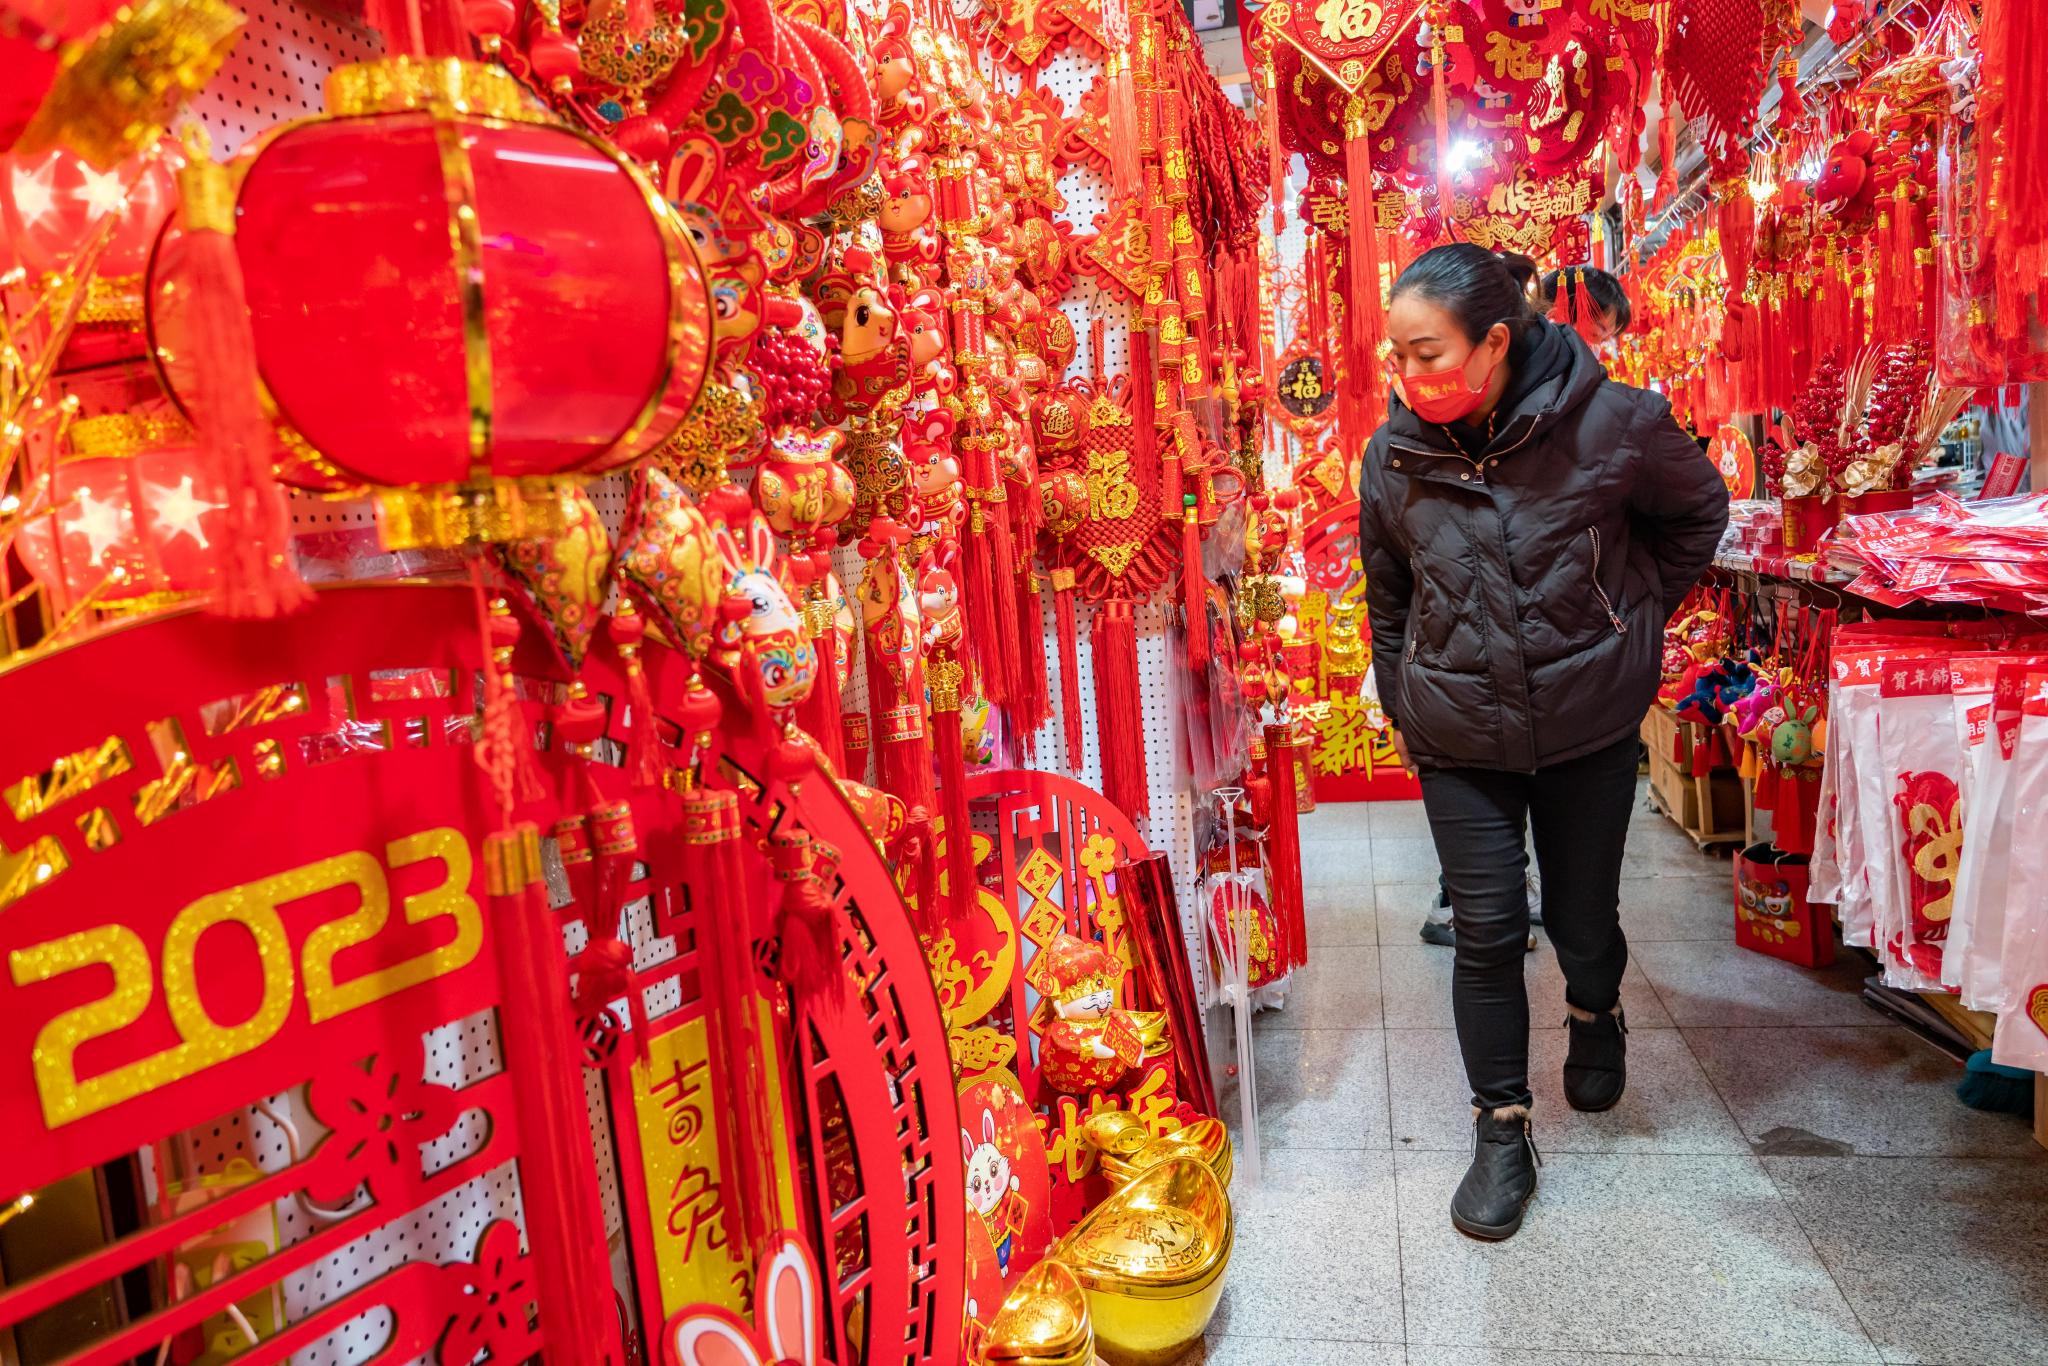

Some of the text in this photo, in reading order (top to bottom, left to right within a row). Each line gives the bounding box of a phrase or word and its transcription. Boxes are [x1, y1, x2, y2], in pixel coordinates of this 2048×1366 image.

[1182, 352, 1203, 385] 福
[1291, 373, 1322, 400] 福
[1086, 450, 1139, 522] 福
[9, 827, 485, 1131] 2023
